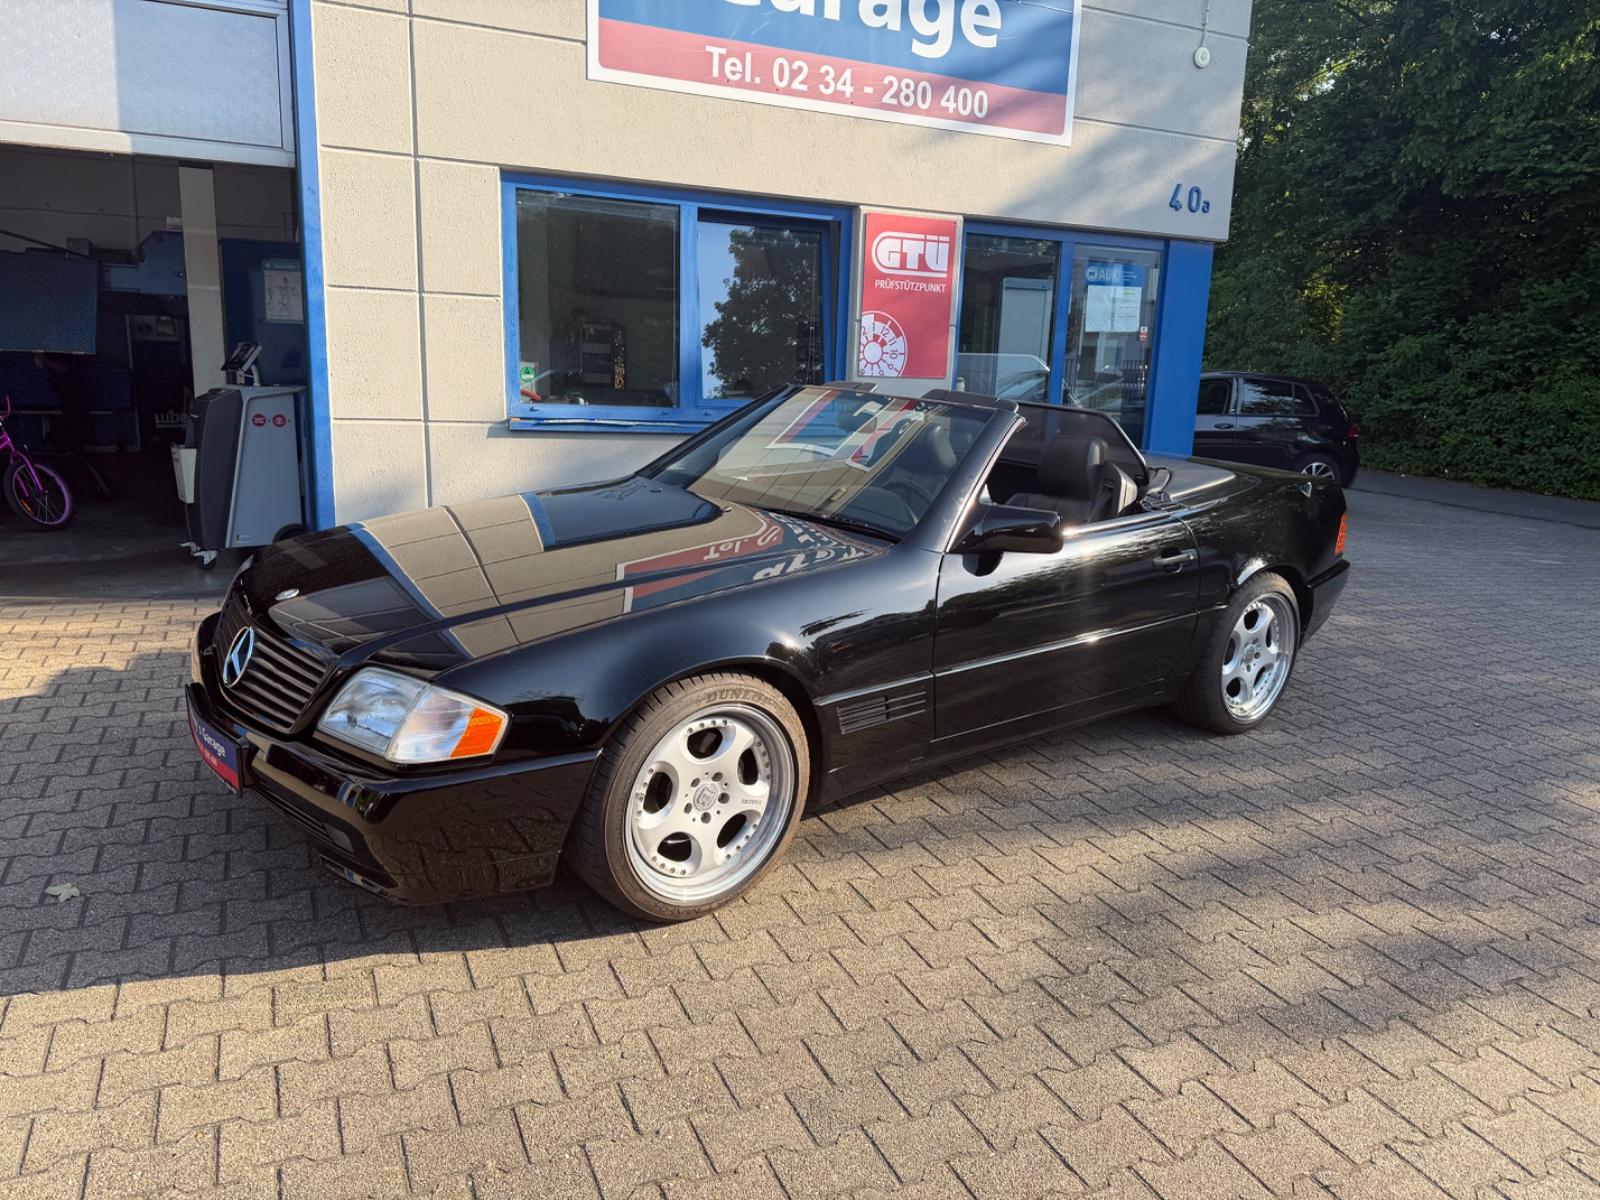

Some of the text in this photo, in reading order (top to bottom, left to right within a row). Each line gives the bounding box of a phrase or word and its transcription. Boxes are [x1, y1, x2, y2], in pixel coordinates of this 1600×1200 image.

[705, 46, 761, 84] Tel.
[772, 57, 809, 91] 02
[818, 64, 854, 97] 34
[881, 75, 932, 110] 280
[940, 85, 988, 118] 400
[1169, 183, 1210, 214] 40a
[874, 233, 950, 273] GTÜ
[874, 279, 946, 294] PRÜFSTÜTZPUNKT
